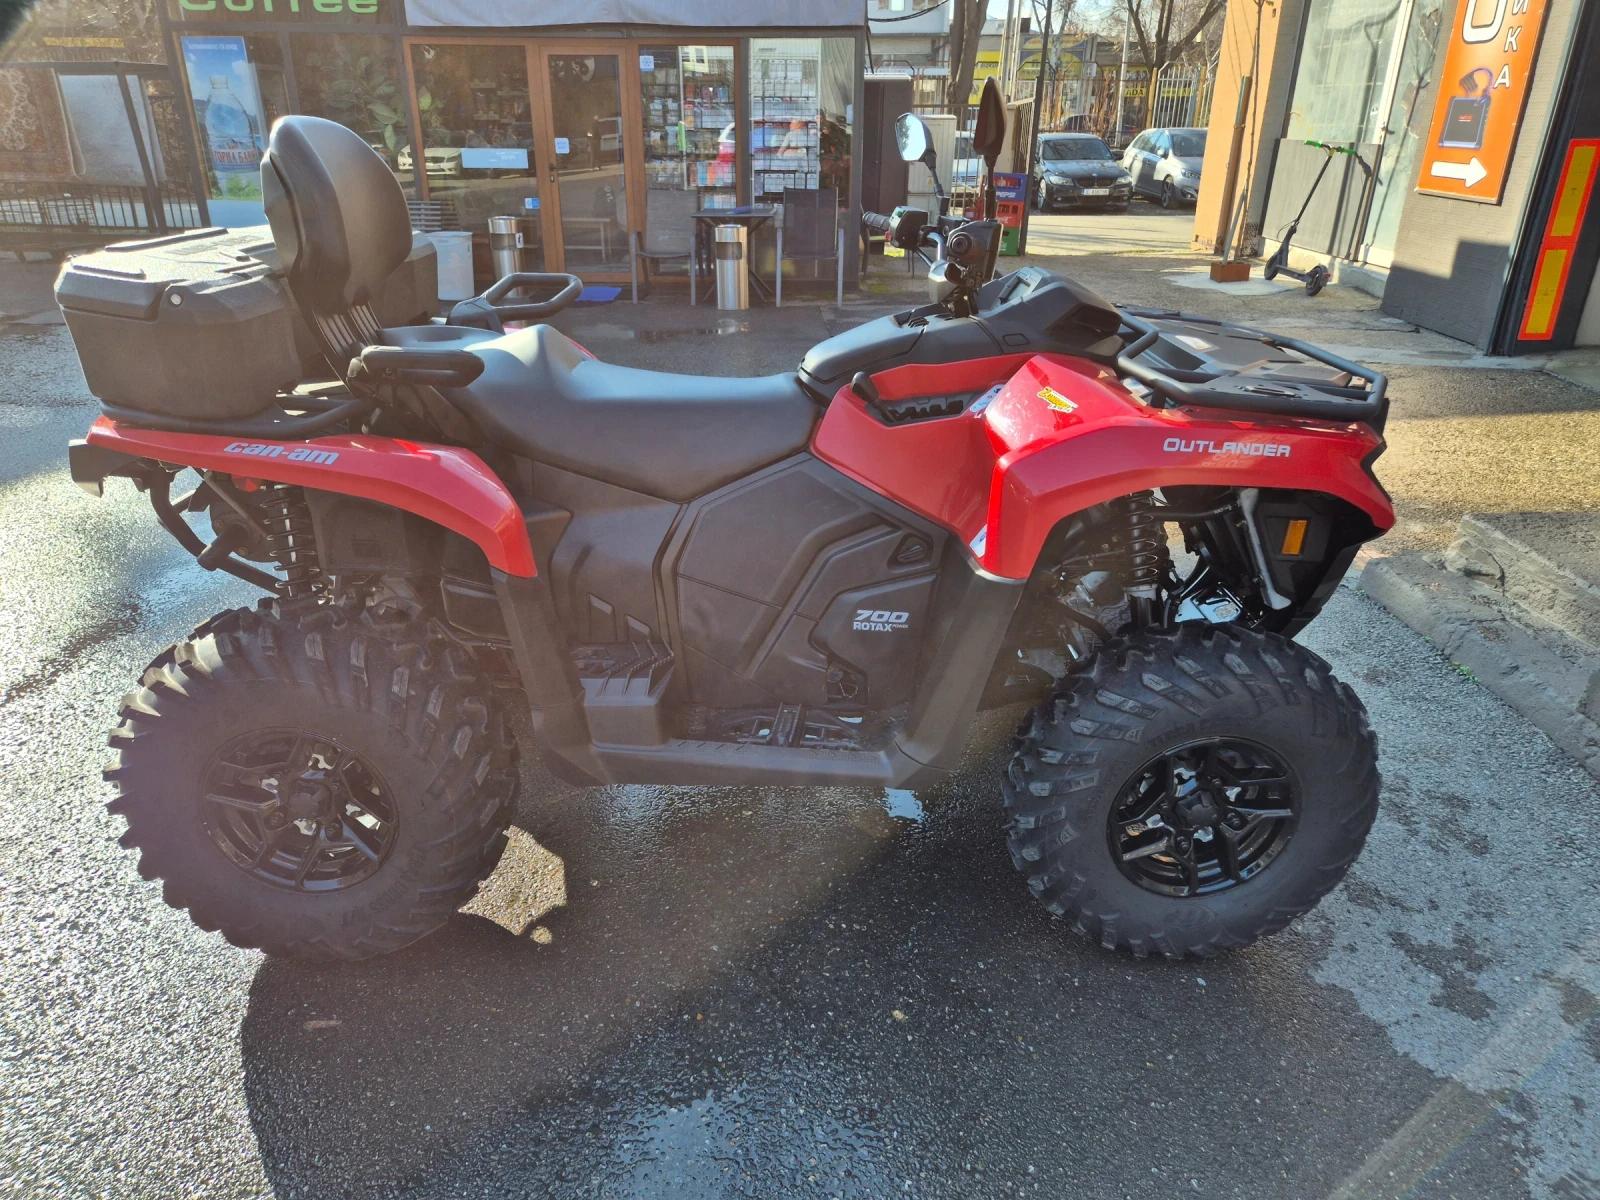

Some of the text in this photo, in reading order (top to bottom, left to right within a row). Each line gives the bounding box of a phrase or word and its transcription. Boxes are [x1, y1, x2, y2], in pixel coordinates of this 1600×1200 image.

[224, 442, 339, 465] can-am
[854, 609, 910, 623] 700
[853, 621, 892, 632] ROTAX
